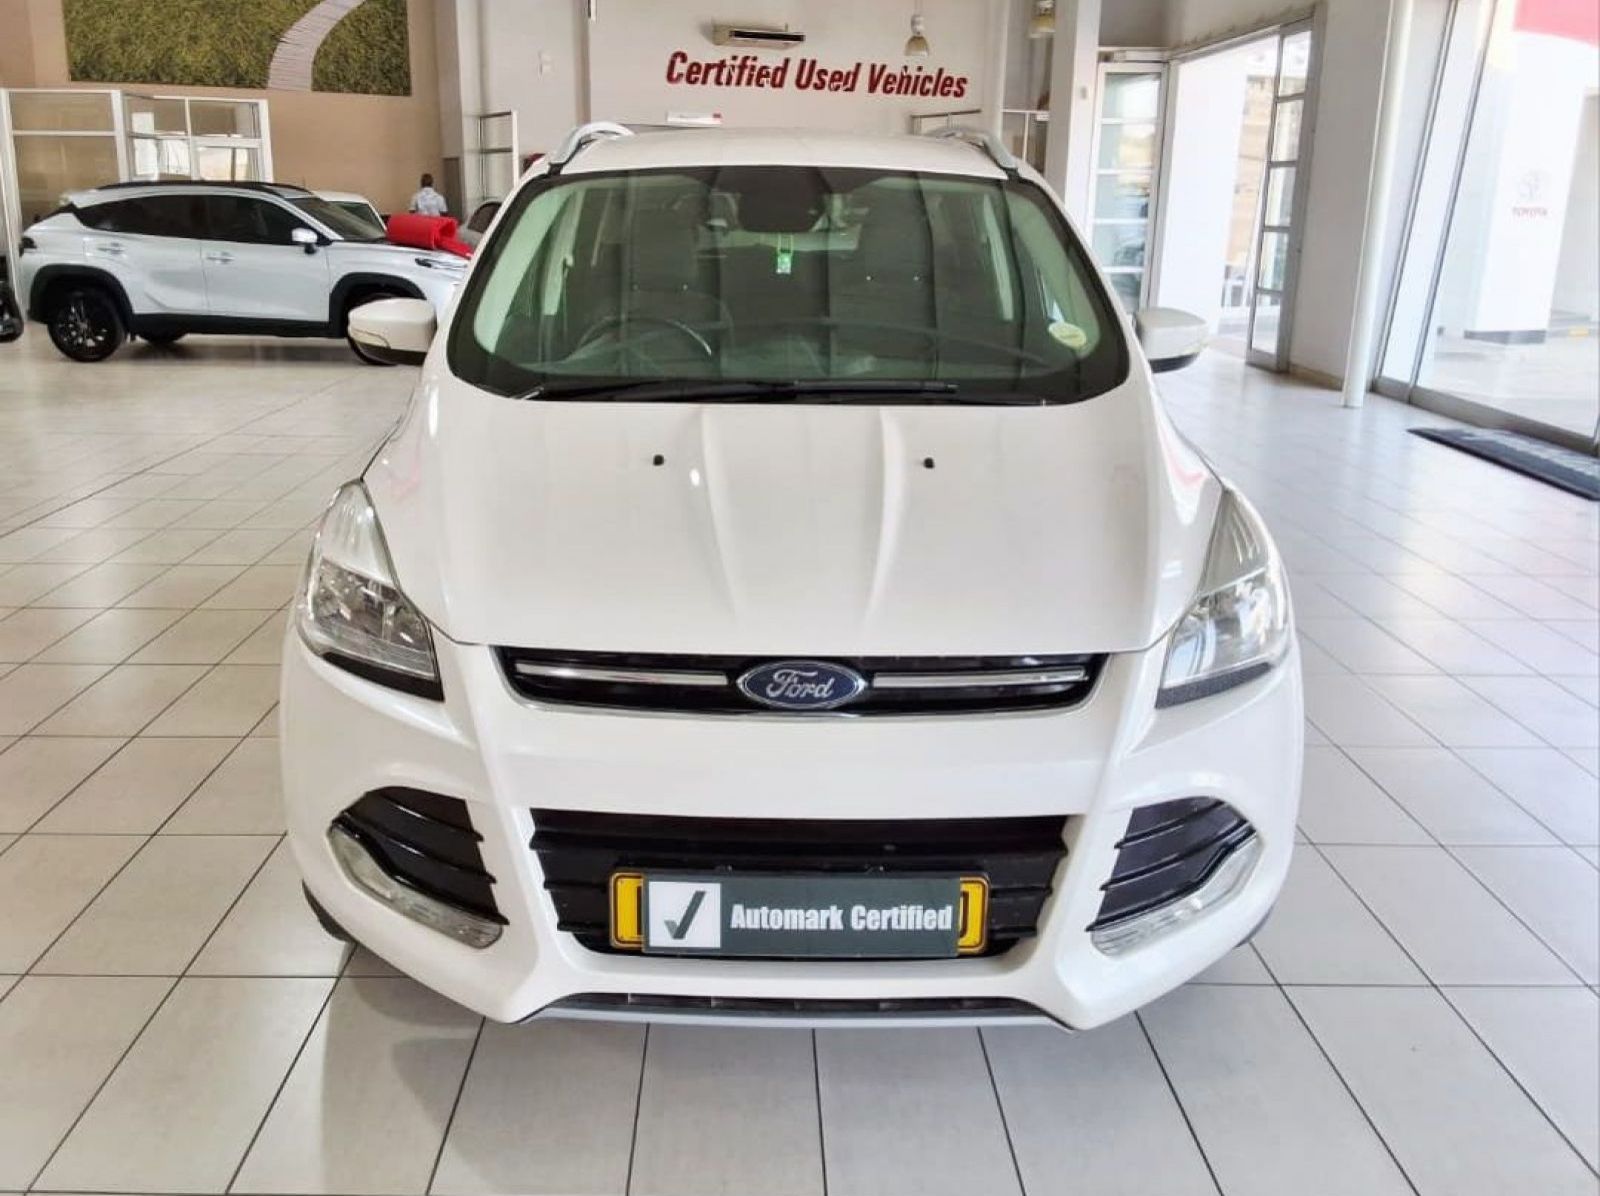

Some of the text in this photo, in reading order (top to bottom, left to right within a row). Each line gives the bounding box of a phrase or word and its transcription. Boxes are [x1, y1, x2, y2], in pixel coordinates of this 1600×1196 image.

[666, 51, 968, 98] Certified Used Vehicles
[765, 669, 836, 698] Ford
[730, 904, 843, 930] Automark
[850, 904, 954, 931] Certified
